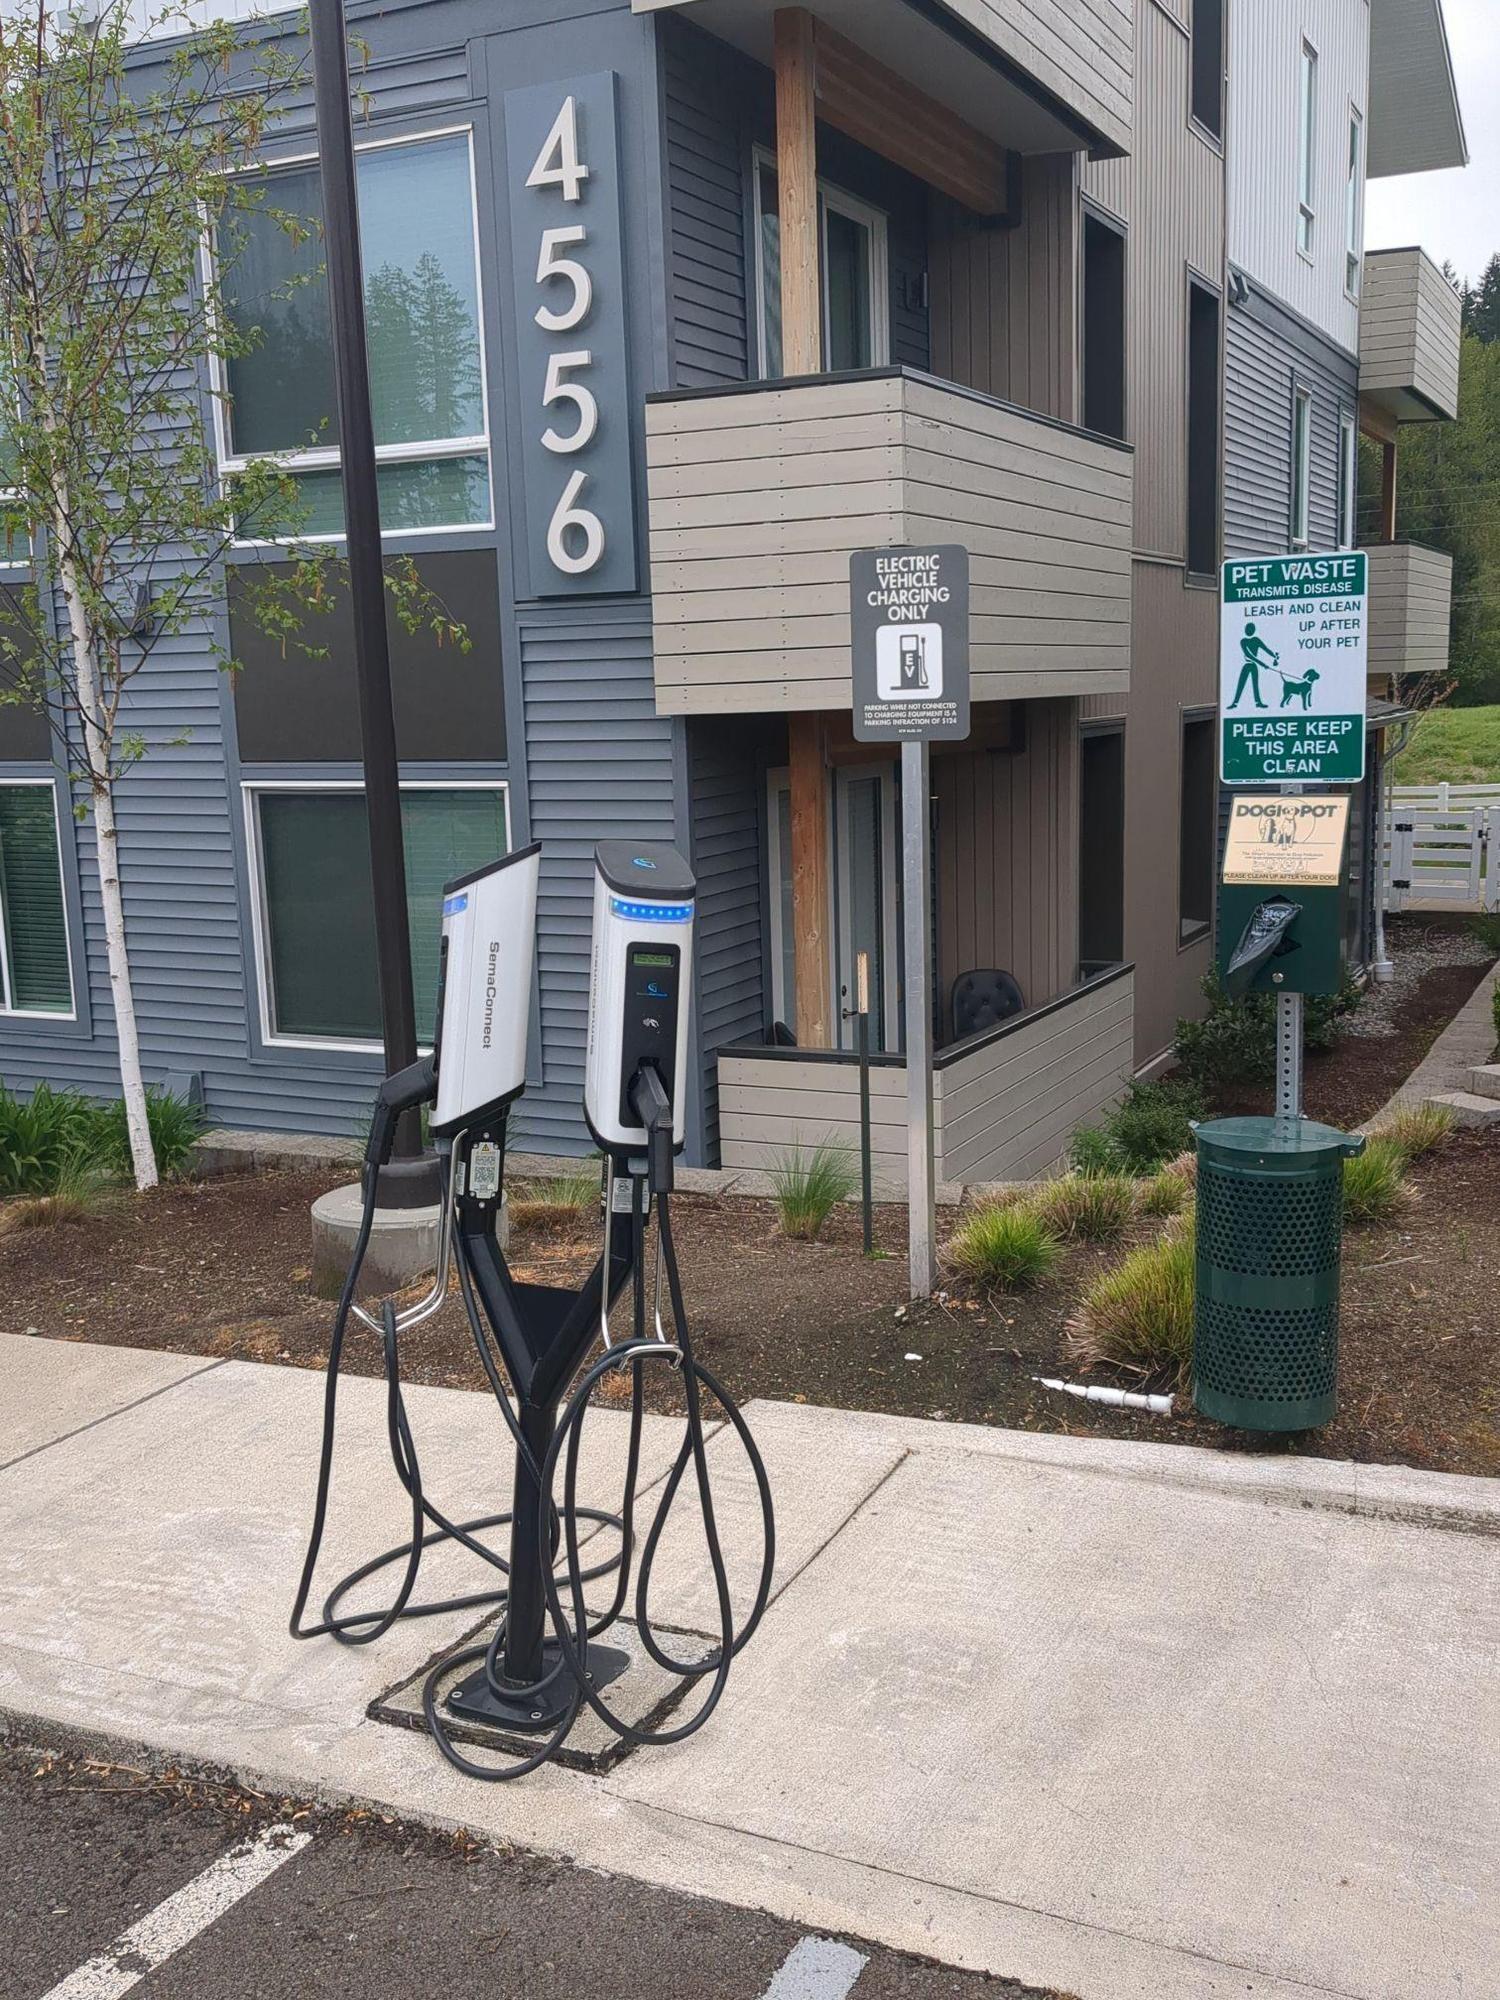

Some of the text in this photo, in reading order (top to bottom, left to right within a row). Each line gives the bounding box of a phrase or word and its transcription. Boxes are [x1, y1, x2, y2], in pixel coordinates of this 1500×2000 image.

[525, 95, 605, 574] 4556
[876, 554, 940, 574] ELECTRIC
[1231, 559, 1356, 584] PET WASTE
[878, 571, 938, 589] VEHICLE
[867, 587, 950, 606] CHARGING
[1236, 582, 1352, 599] TRANSMITS DISEASE
[888, 604, 930, 621] ONLY
[1244, 600, 1361, 617] LEASH AND CLEAN
[1299, 618, 1360, 632] UP AFTER
[1297, 636, 1360, 650] YOUR PET
[864, 702, 957, 712] PARKING WHILE NOT CONNECTED
[874, 710, 907, 718] CHARGING
[908, 710, 943, 718] EQUIPMENT
[952, 709, 958, 717] A
[892, 718, 930, 726] INFRACTION
[1232, 721, 1352, 738] PLEASE KEEP
[1245, 740, 1339, 756] THIS AREA
[1263, 759, 1321, 774] CLEAN
[482, 941, 499, 1049] SemaConnect
